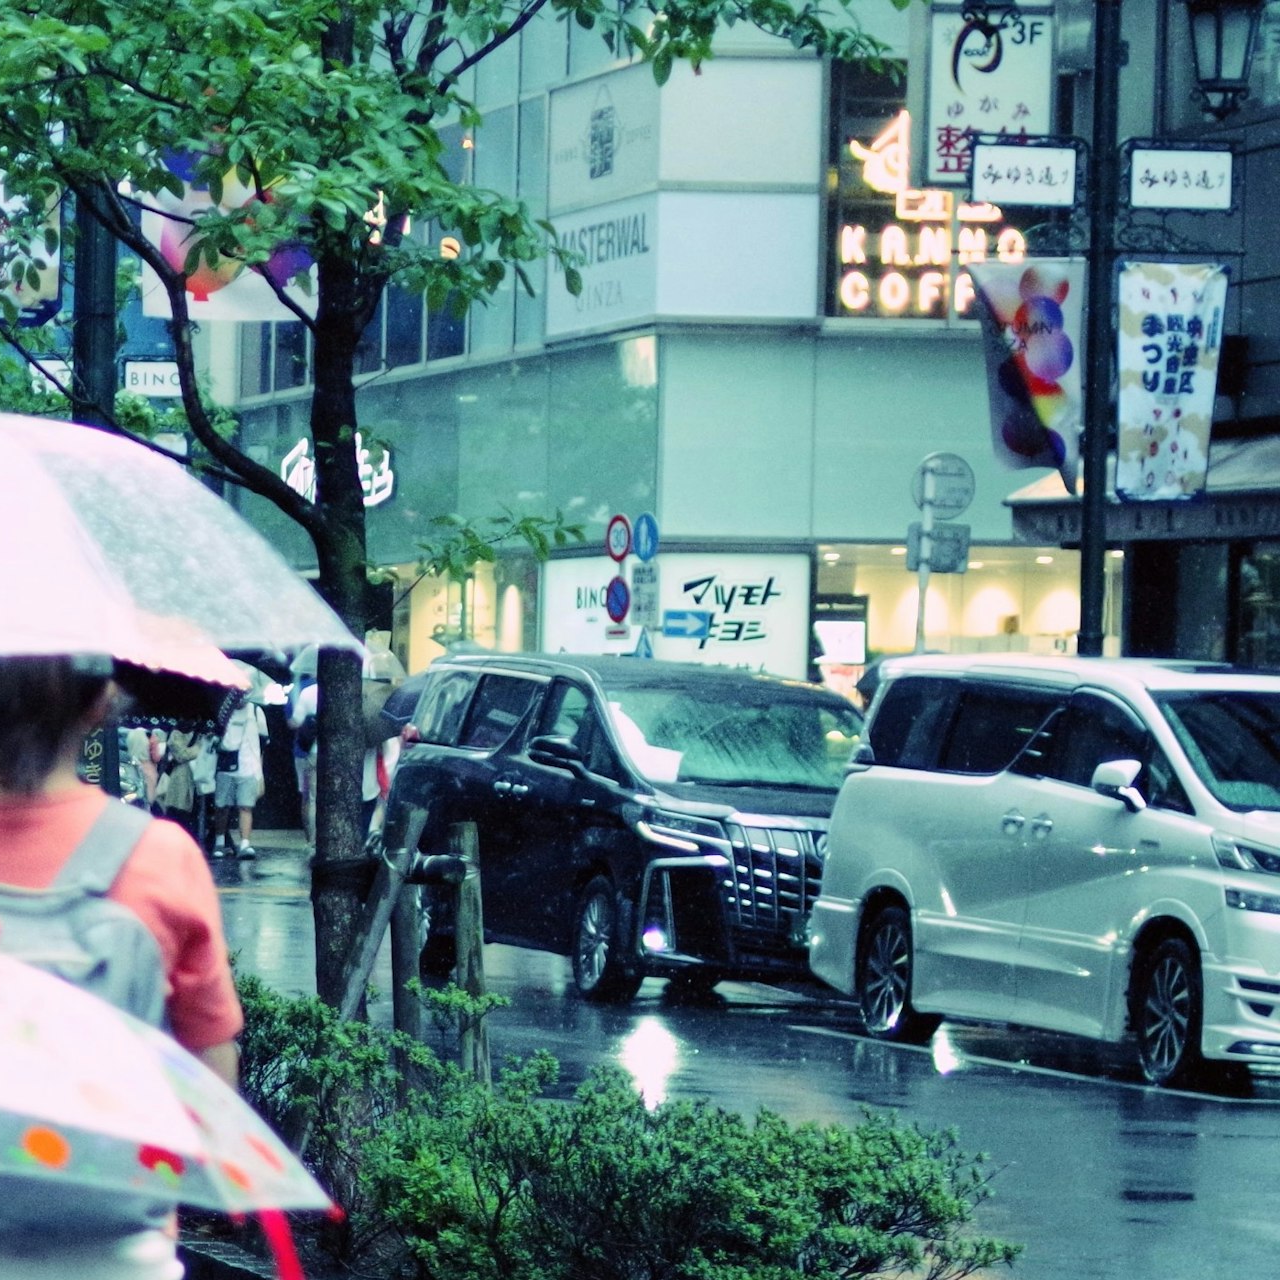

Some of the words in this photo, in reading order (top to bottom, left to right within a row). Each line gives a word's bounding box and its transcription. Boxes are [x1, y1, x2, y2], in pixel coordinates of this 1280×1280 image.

[1011, 19, 1044, 45] 3F
[947, 96, 1032, 120] ゆがみ
[982, 163, 1069, 187] みゆき通り
[1139, 168, 1226, 190] みゆき通り
[1141, 313, 1164, 393] まつり
[612, 529, 625, 550] 30
[683, 575, 781, 614] マツモト
